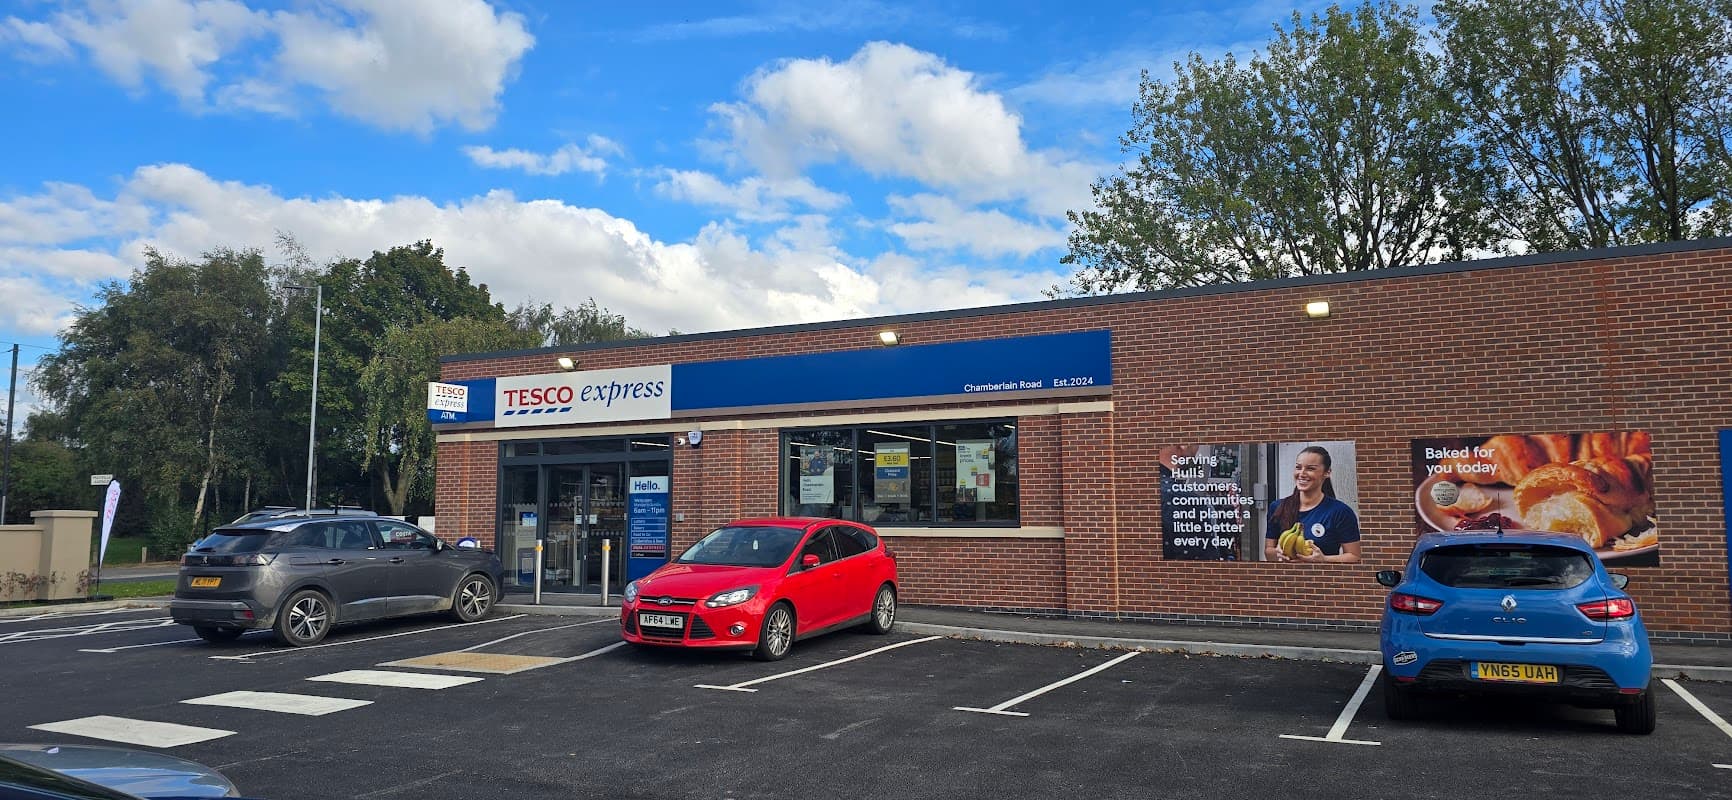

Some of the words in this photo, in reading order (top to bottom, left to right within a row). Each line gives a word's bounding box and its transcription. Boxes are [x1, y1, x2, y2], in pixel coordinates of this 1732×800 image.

[435, 386, 465, 396] TESCO
[503, 386, 574, 407] TESCO
[580, 378, 664, 408] express
[964, 381, 1017, 393] Chamberlain
[1019, 380, 1042, 389] Road
[434, 399, 465, 409] express
[1425, 446, 1469, 459] Baked
[1473, 446, 1495, 458] for
[1170, 454, 1218, 467] Serving
[1426, 464, 1452, 476] you
[1456, 461, 1498, 476] today
[634, 480, 661, 491] Hello.
[1171, 482, 1242, 493] customers,
[1172, 494, 1254, 505] communities
[1172, 507, 1196, 519] and
[1199, 507, 1240, 521] planet
[1242, 510, 1251, 519] a
[1173, 521, 1202, 533] little
[1204, 521, 1245, 533] better
[1173, 537, 1209, 549] every
[1211, 536, 1235, 549] day
[643, 615, 664, 625] AF64
[1480, 663, 1520, 678] YN65
[1524, 665, 1555, 679] UAH
